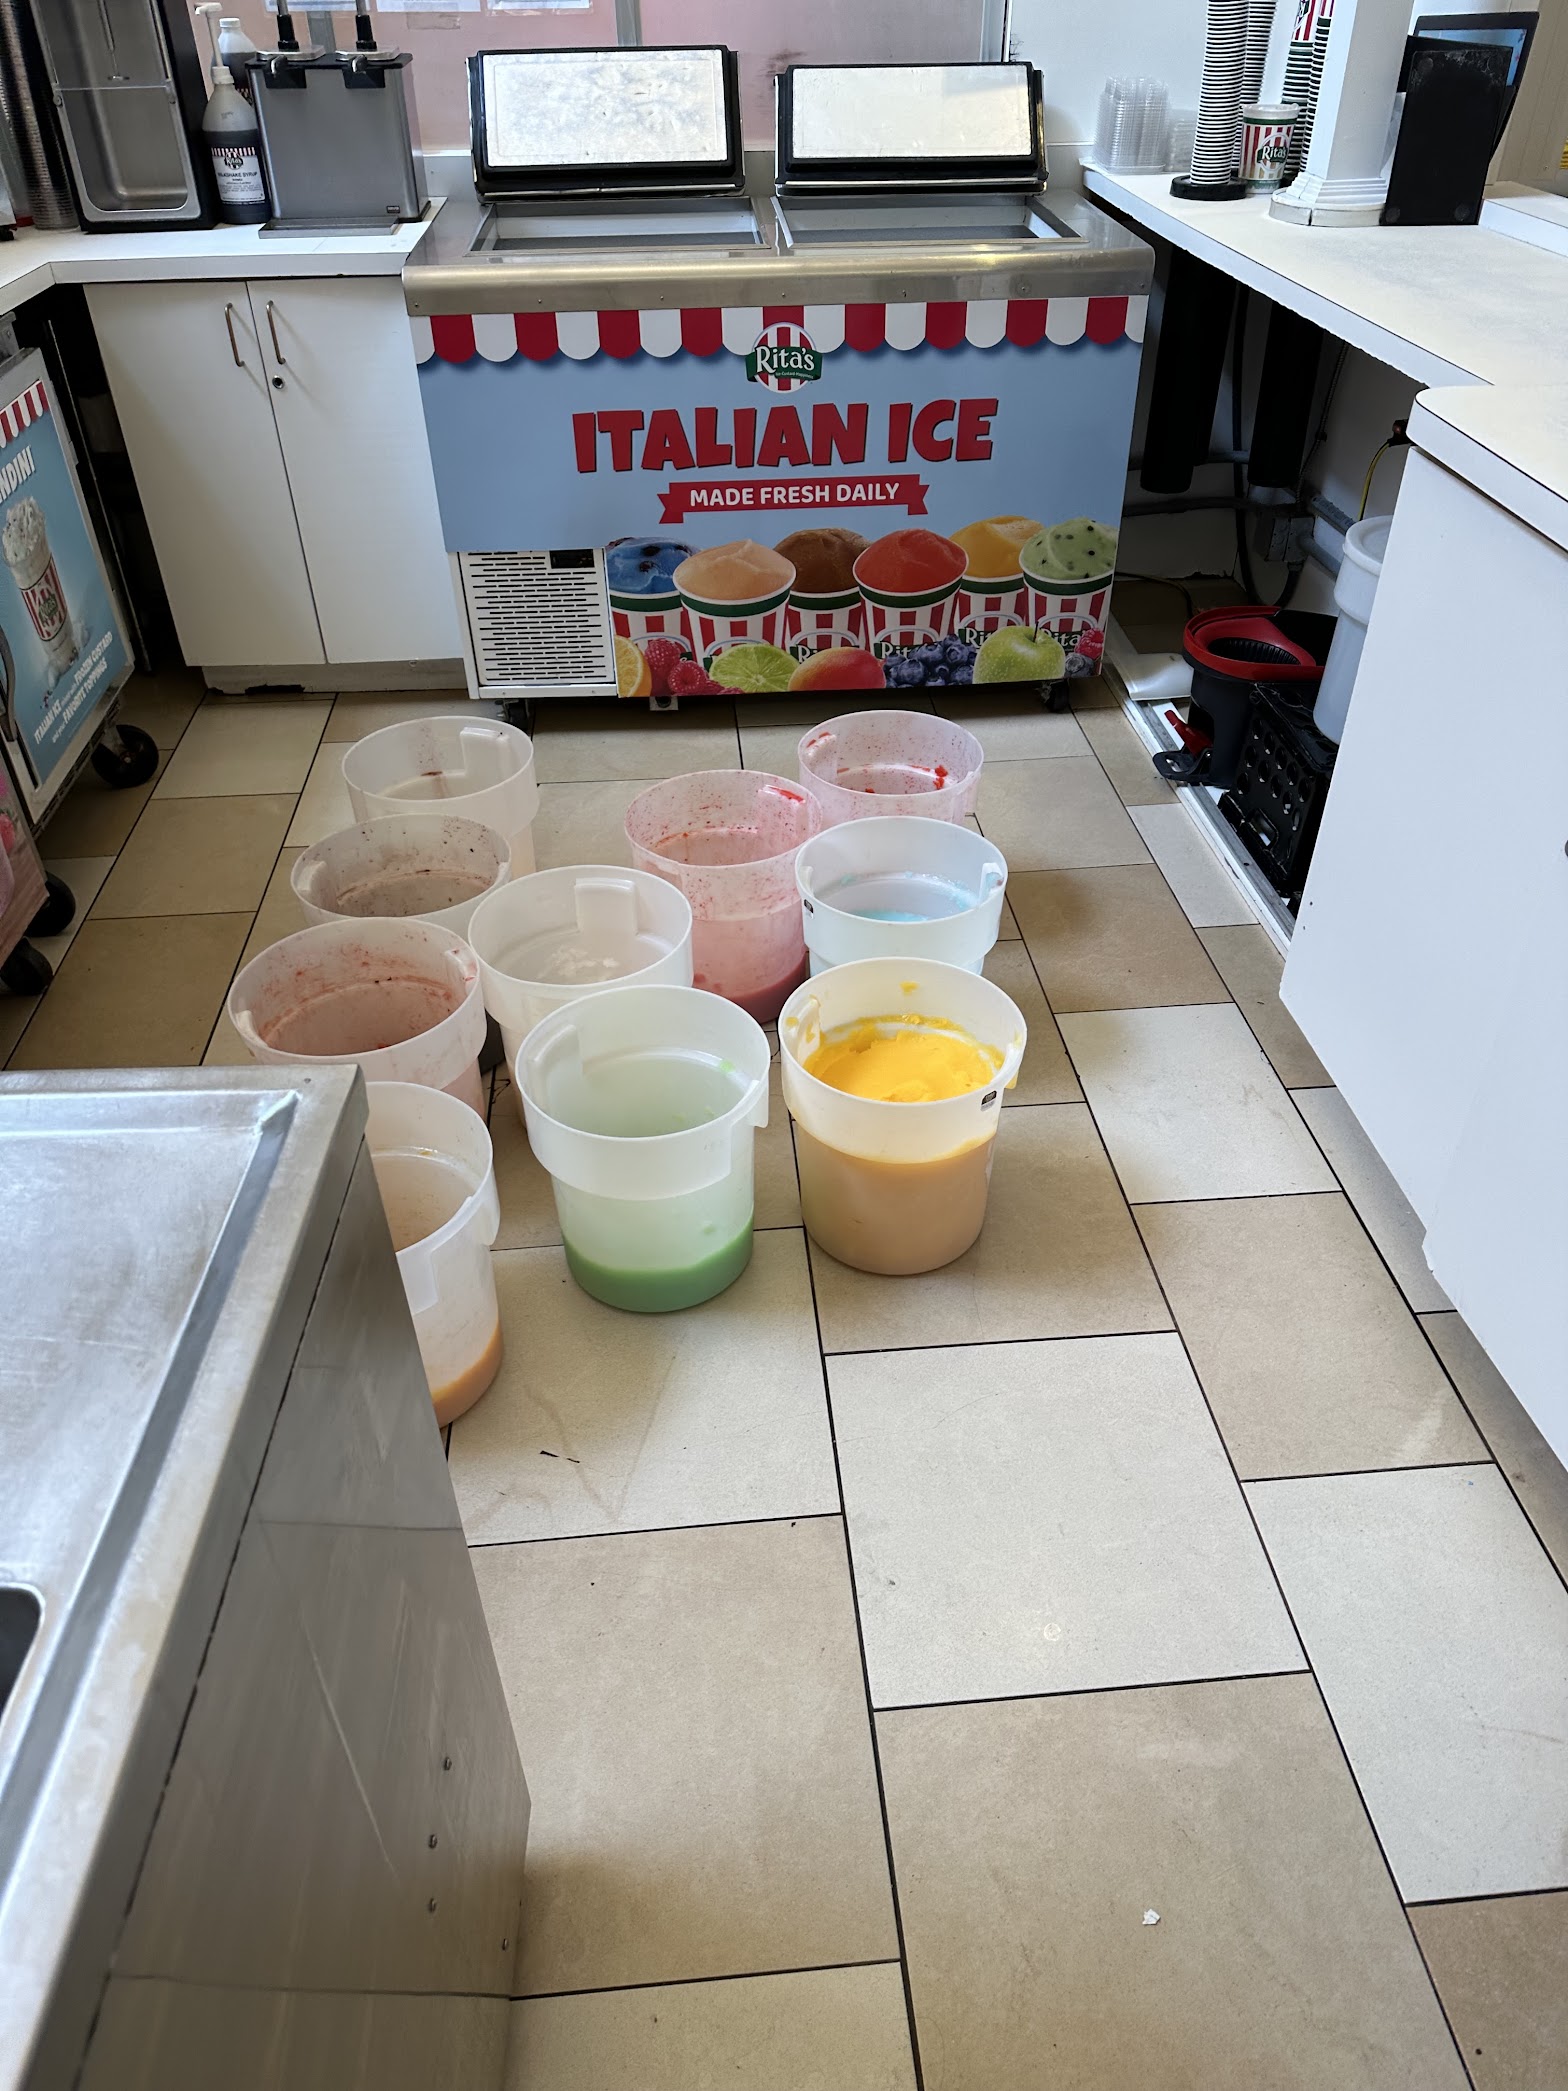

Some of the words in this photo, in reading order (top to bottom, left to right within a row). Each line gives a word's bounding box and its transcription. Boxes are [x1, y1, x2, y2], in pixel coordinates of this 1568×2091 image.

[755, 346, 815, 374] Rita's
[572, 402, 869, 473] ITALIAN
[887, 398, 998, 464] ICE
[0, 445, 36, 504] NDINI
[690, 488, 754, 507] MADE
[760, 485, 830, 505] FRESH
[836, 482, 900, 502] DAILY
